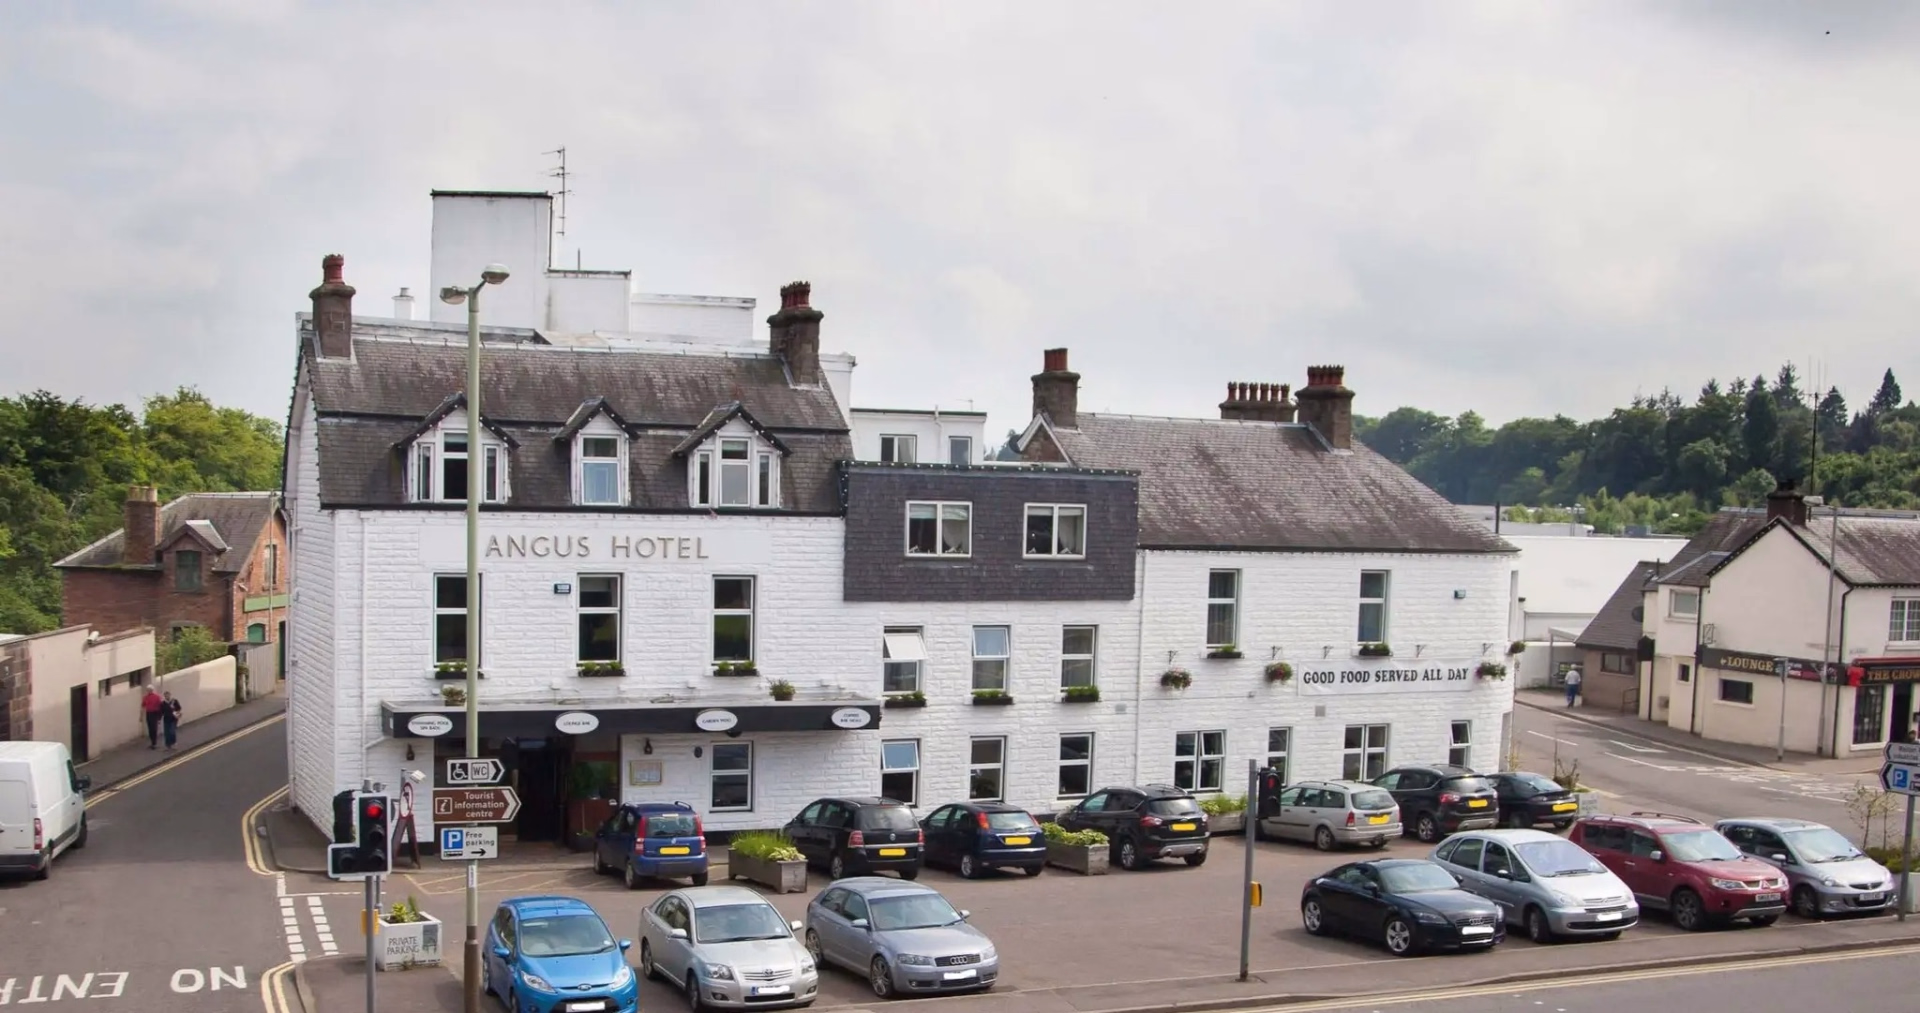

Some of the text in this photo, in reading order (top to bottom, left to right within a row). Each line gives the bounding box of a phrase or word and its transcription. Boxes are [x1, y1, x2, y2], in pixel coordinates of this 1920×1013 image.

[485, 534, 709, 559] ANGUS HOTEL
[1727, 656, 1775, 672] LOUNGE
[1303, 667, 1469, 684] GOOD FOOD SERVED ALL DAY
[1867, 670, 1890, 680] THE
[472, 766, 488, 776] WC
[1894, 770, 1904, 786] P
[464, 791, 495, 800] Tourist
[454, 801, 505, 809] information
[465, 810, 494, 818] centre
[448, 831, 461, 848] P
[465, 831, 483, 839] Free
[465, 839, 495, 848] parking
[388, 936, 418, 946] PRIVATE
[386, 945, 420, 955] PARKING
[169, 965, 248, 994] NO
